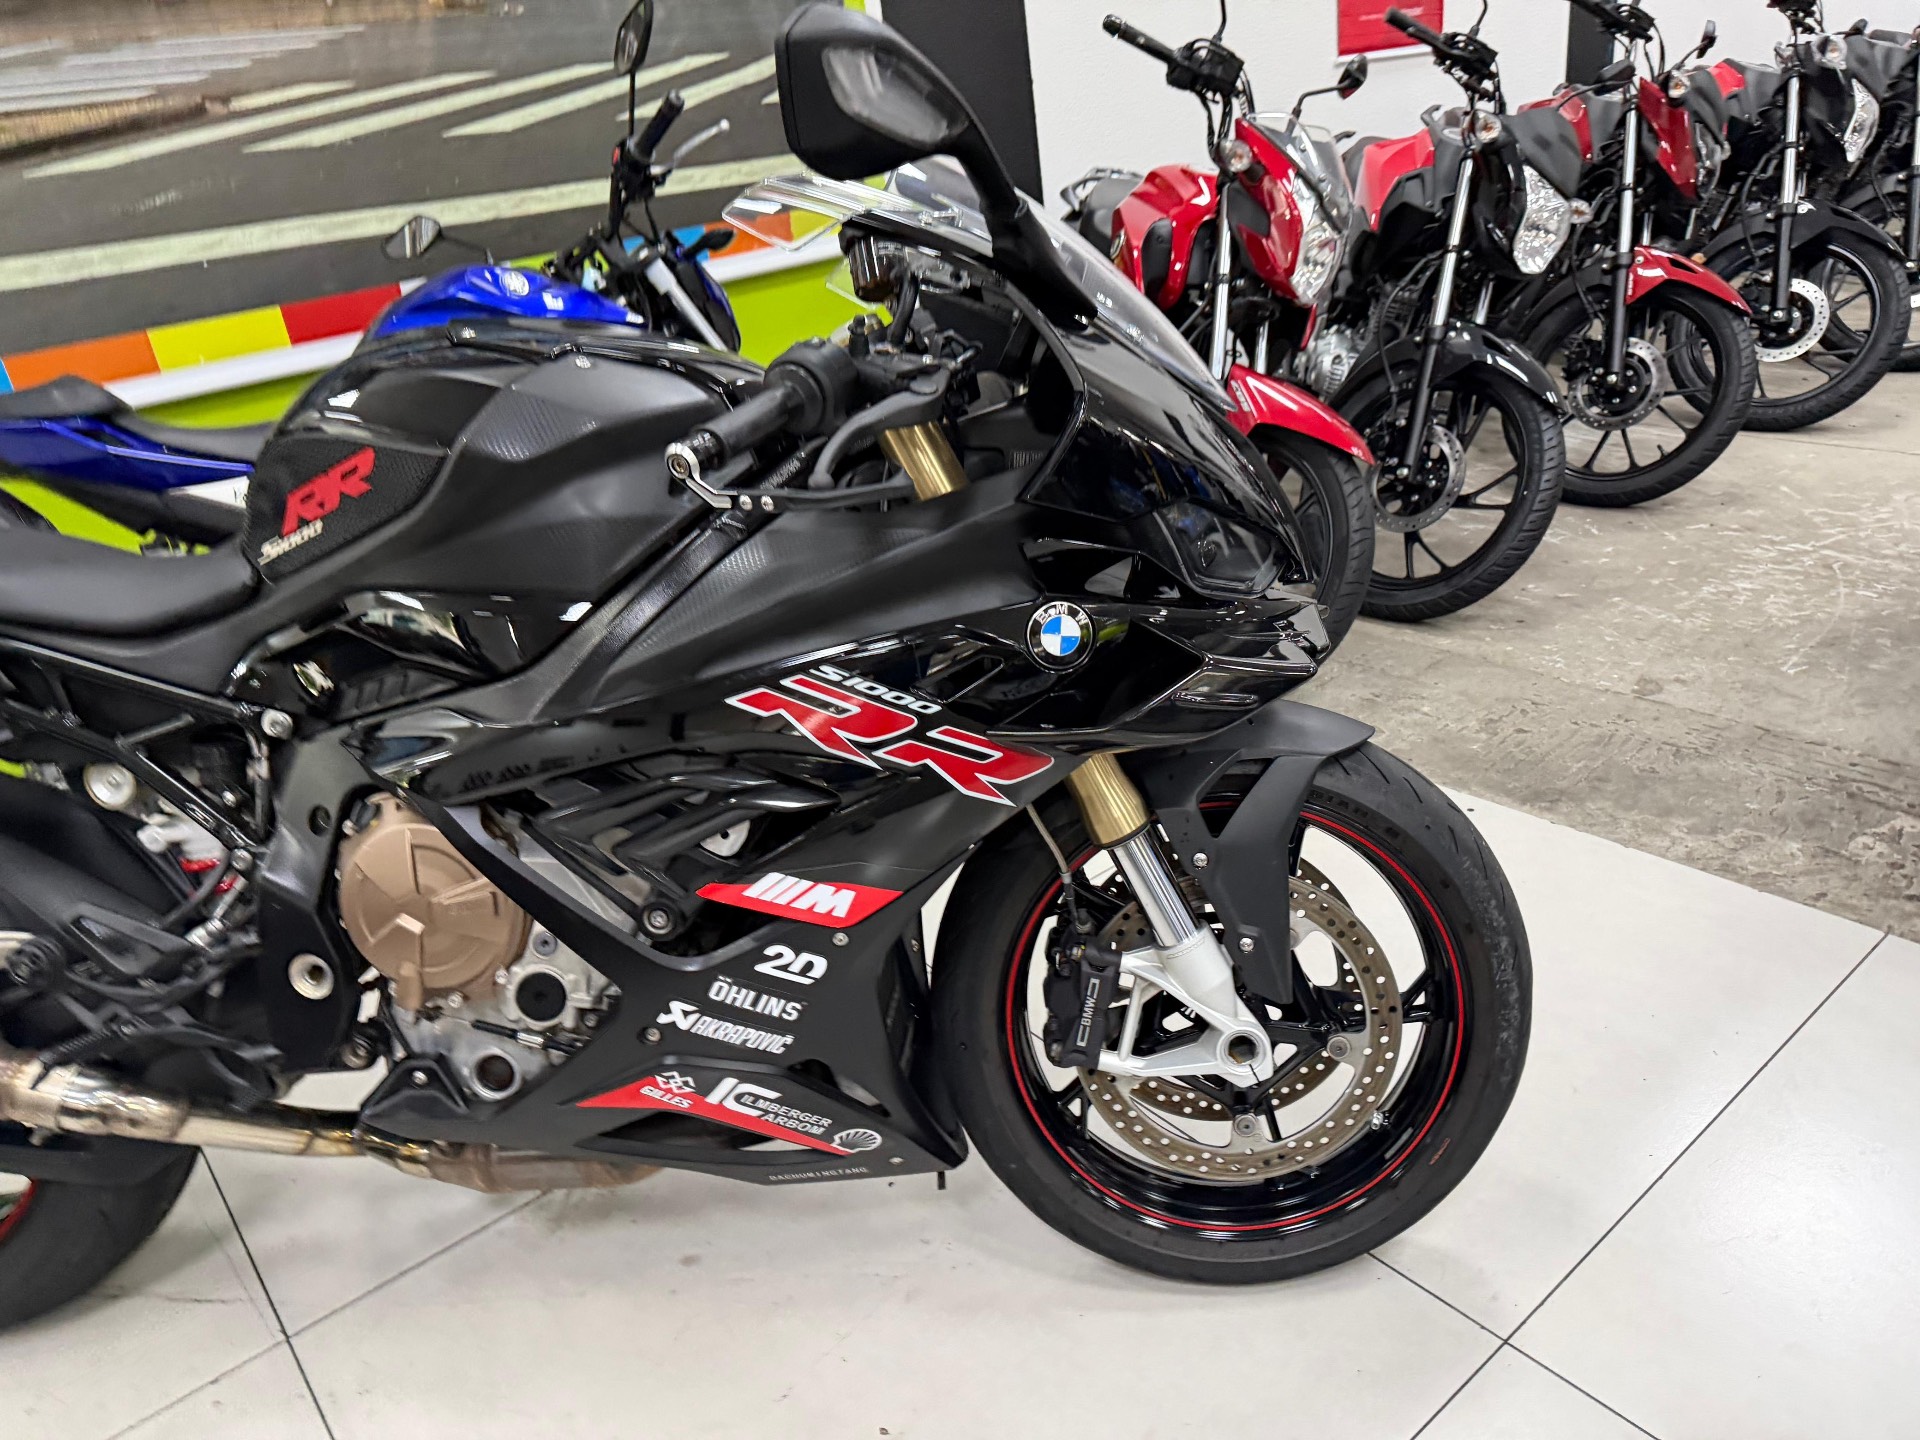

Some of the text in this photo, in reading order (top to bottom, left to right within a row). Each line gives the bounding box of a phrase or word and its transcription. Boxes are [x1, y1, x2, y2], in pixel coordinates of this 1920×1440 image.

[1035, 603, 1090, 626] BMW
[809, 664, 942, 714] S1000
[725, 674, 1055, 807] RR
[708, 975, 802, 1021] ÖHLINS
[1079, 998, 1099, 1027] BMW
